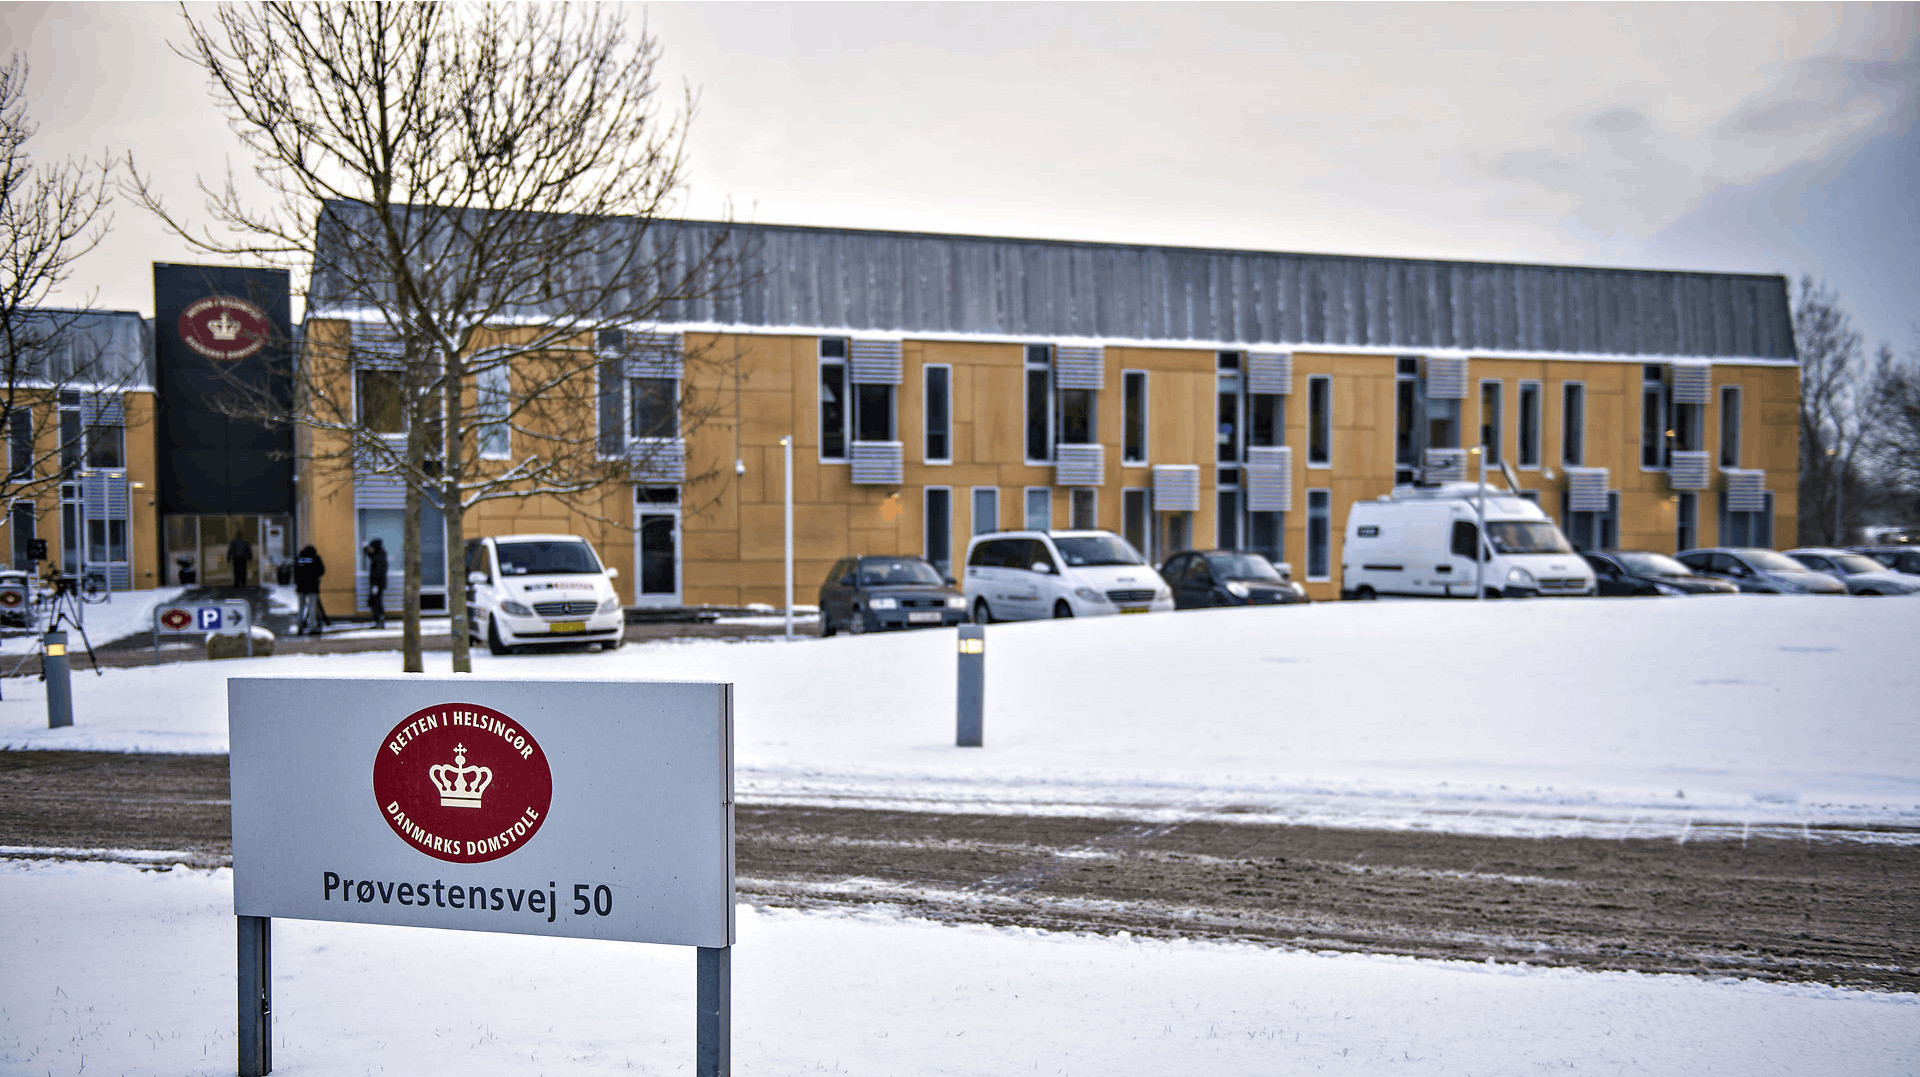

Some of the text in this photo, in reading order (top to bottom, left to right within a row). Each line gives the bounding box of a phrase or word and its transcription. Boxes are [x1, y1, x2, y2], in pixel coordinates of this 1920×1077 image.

[203, 609, 218, 629] P
[389, 711, 534, 760] RETTEN I HELSINGØR
[386, 801, 539, 856] DANMARKS DOMSTOLE
[323, 871, 613, 923] Prøvestensvej 50
